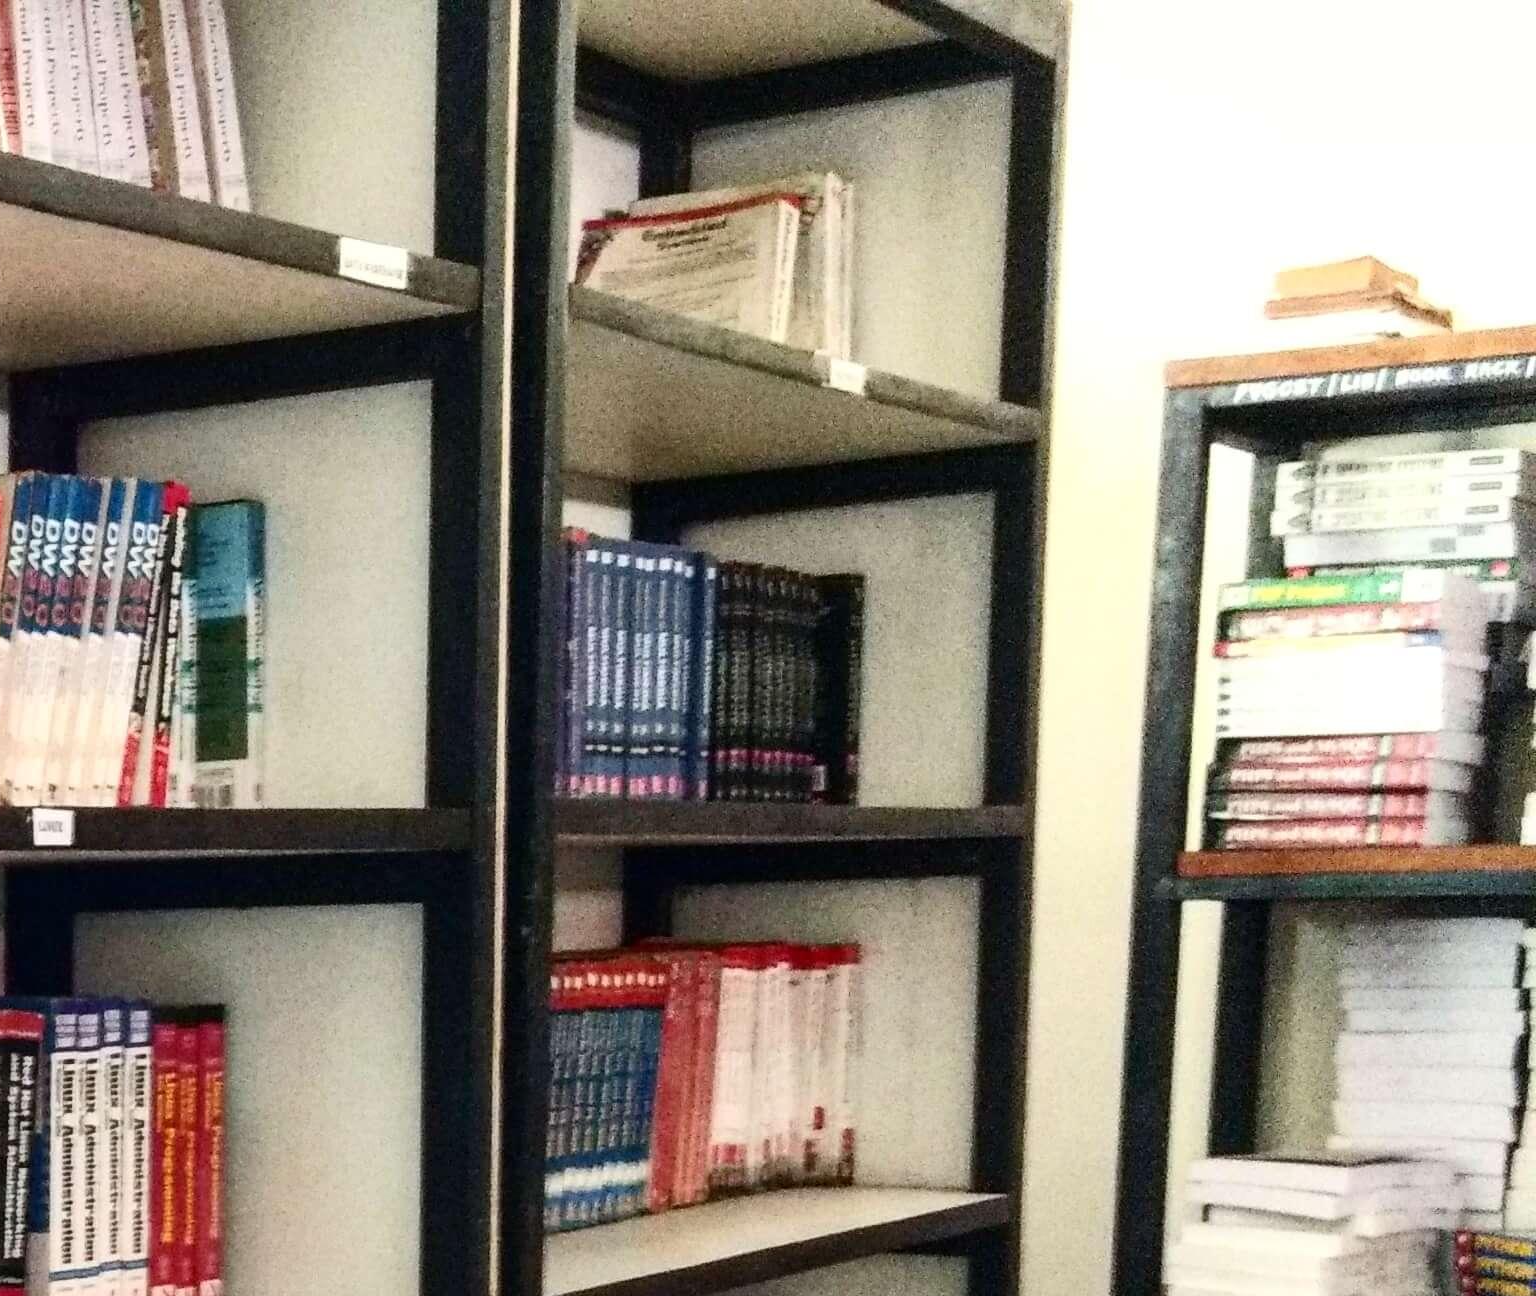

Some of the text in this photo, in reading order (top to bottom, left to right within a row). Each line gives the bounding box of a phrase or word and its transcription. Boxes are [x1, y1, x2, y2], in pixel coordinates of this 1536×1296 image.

[60, 1057, 75, 1266] Linux Administration
[83, 1056, 99, 1263] Linux Administration
[108, 1052, 122, 1256] Linux Administration
[132, 1053, 148, 1255] Linux Administration
